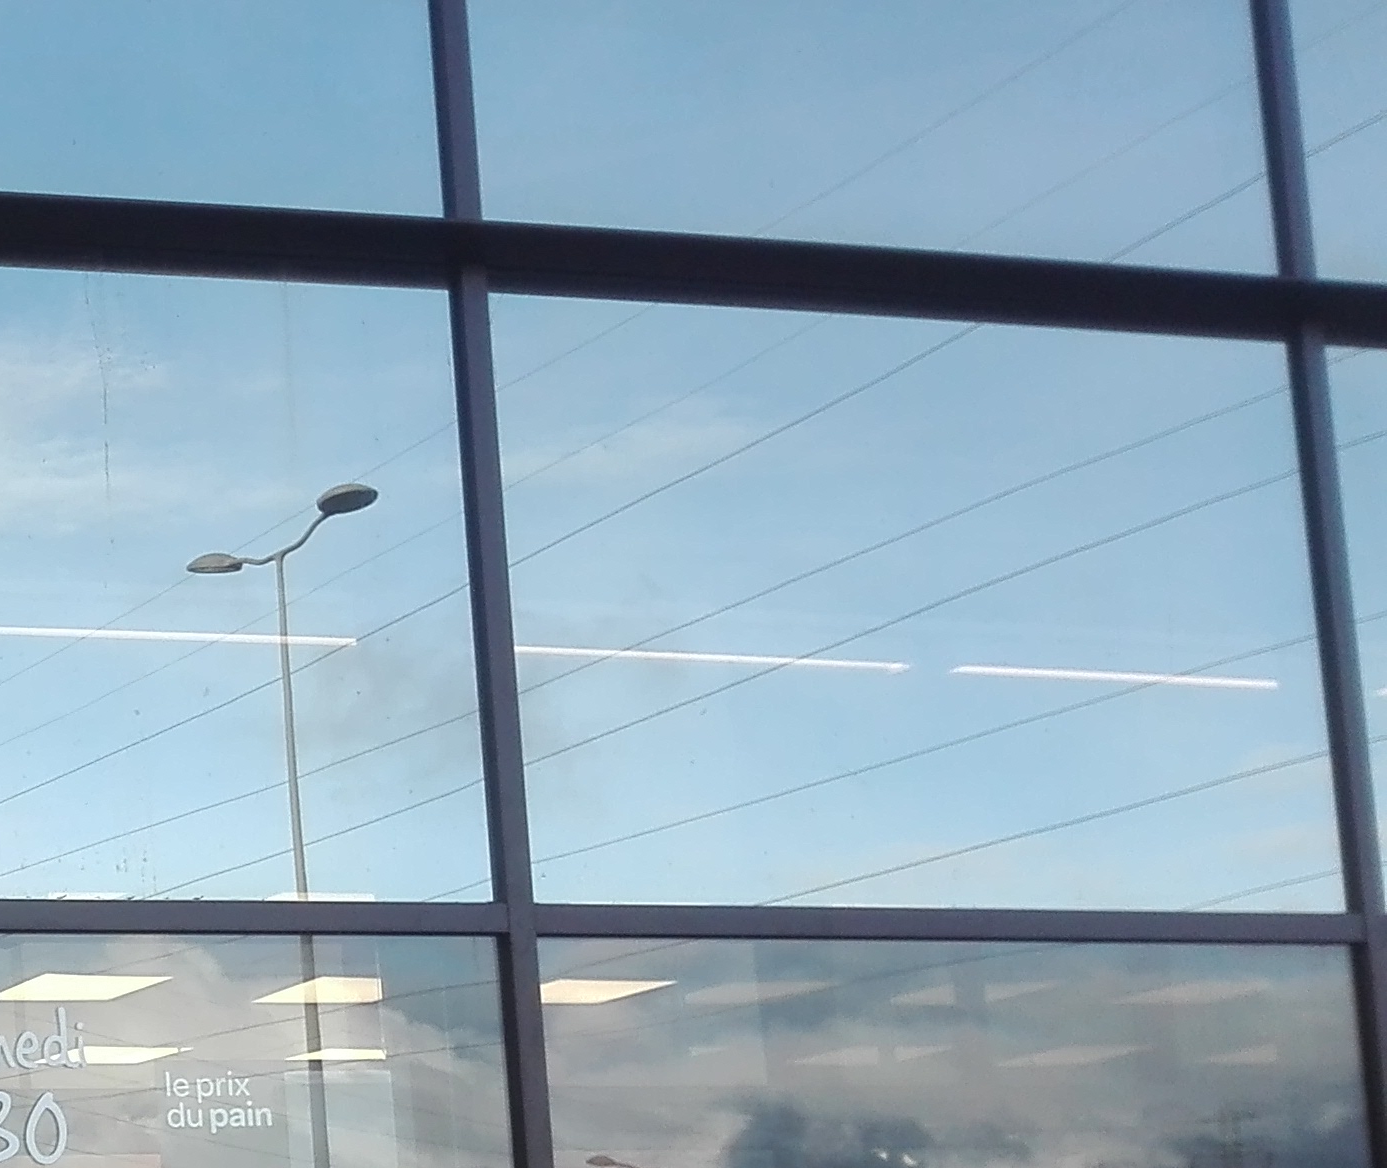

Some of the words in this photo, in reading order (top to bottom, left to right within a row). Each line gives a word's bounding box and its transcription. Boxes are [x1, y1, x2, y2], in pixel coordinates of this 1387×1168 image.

[164, 1070, 191, 1097] le
[196, 1070, 251, 1104] prix
[167, 1101, 204, 1128] du
[209, 1100, 273, 1134] pain
